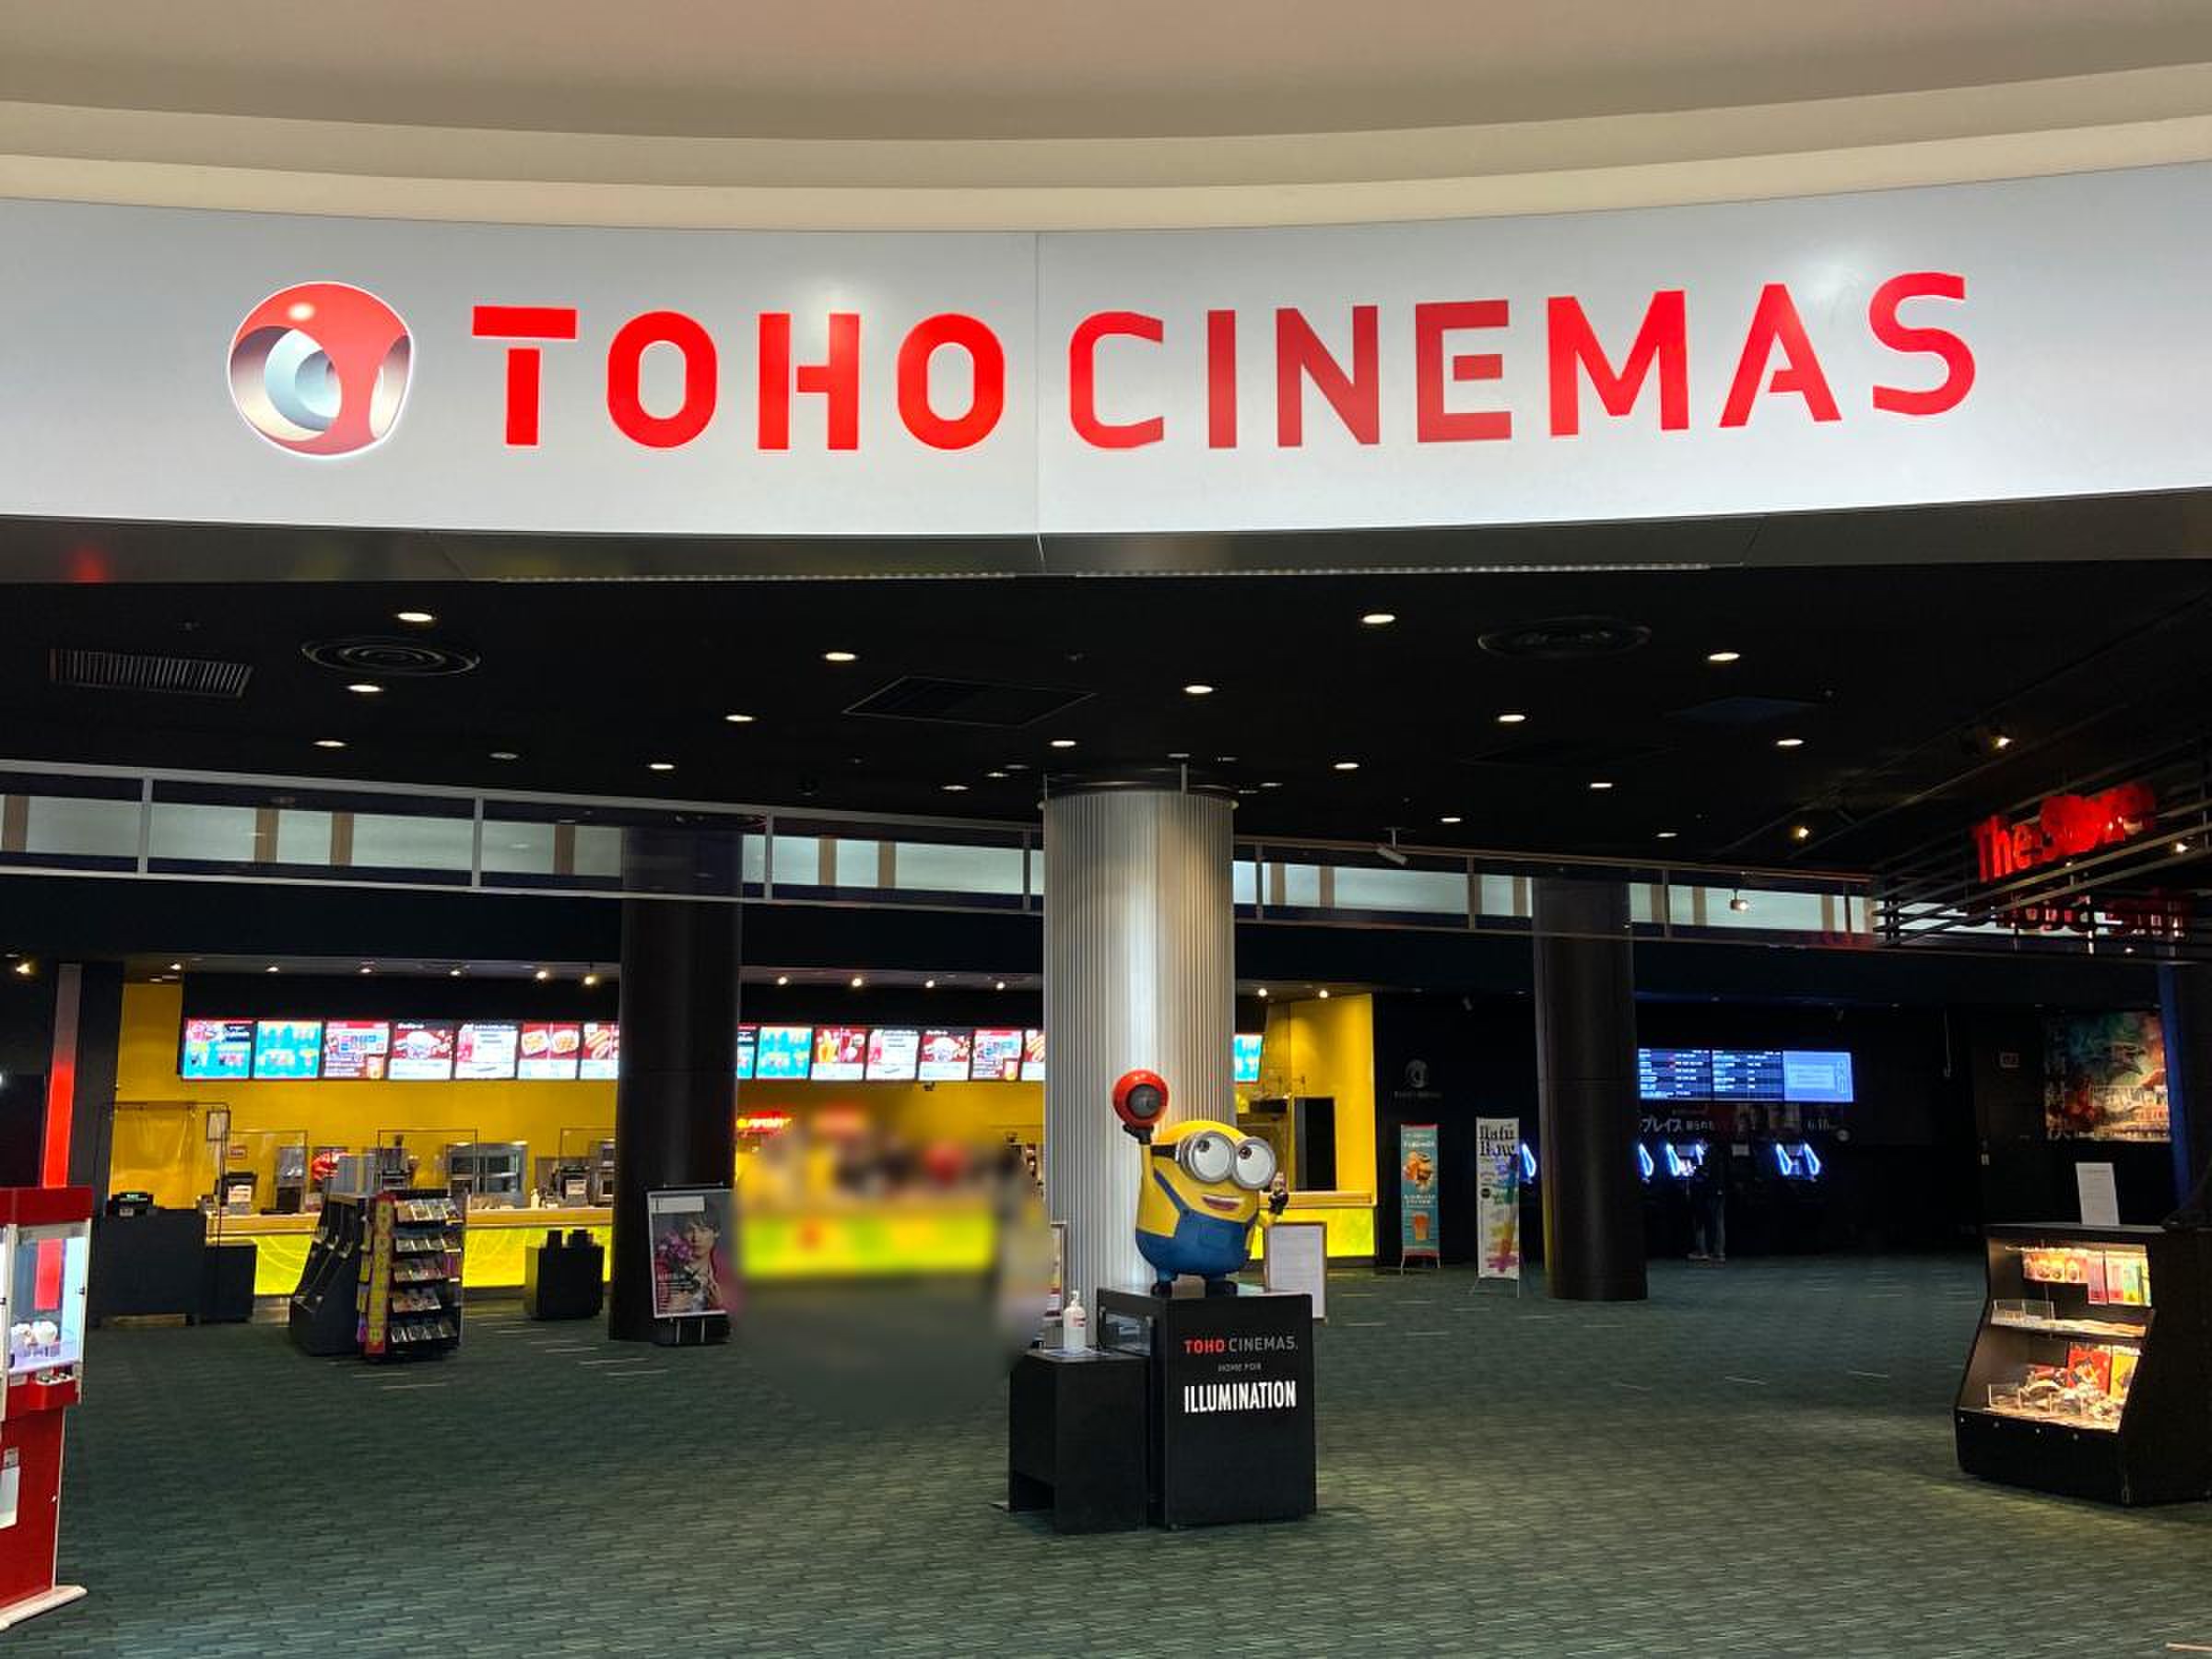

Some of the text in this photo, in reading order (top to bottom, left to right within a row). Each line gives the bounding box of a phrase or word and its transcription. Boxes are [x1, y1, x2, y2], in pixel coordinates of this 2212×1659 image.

[472, 271, 1977, 453] TOHO CINEMAS
[1185, 1339, 1225, 1354] TOHO
[1184, 1382, 1297, 1413] ILLUMINATION
